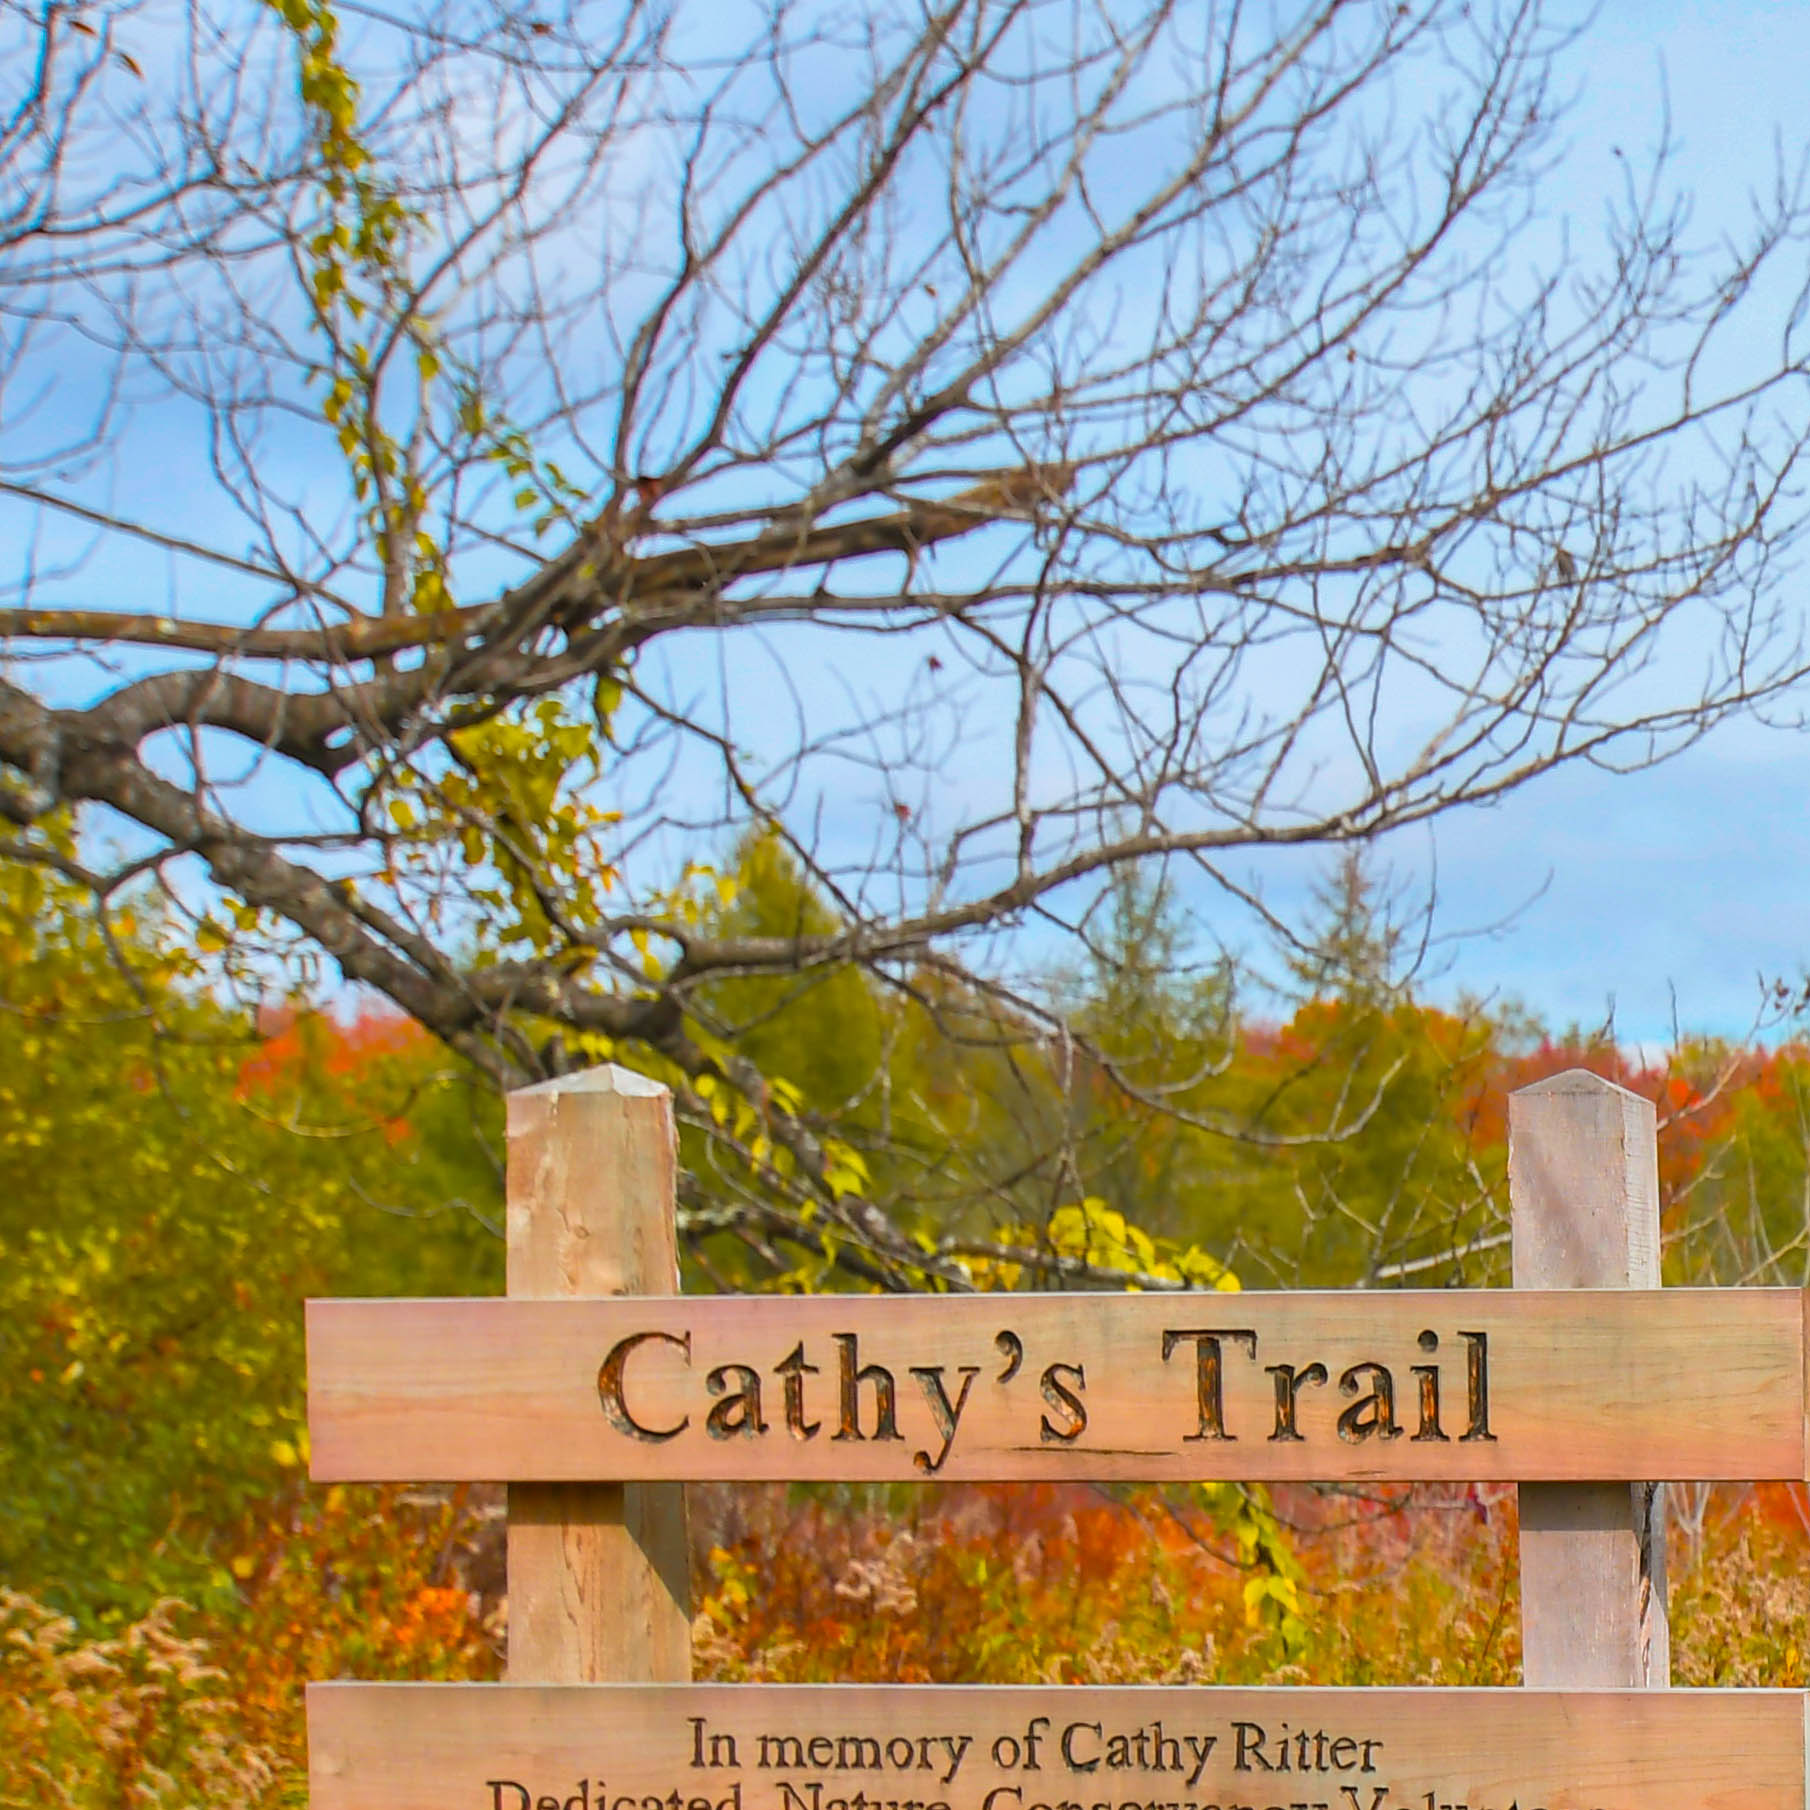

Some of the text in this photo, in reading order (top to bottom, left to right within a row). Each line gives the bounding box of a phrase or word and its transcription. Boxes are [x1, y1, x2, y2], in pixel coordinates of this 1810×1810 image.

[597, 1329, 1498, 1474] Cathy's Trail
[688, 1717, 1383, 1787] In memory of Cathy Ritter
